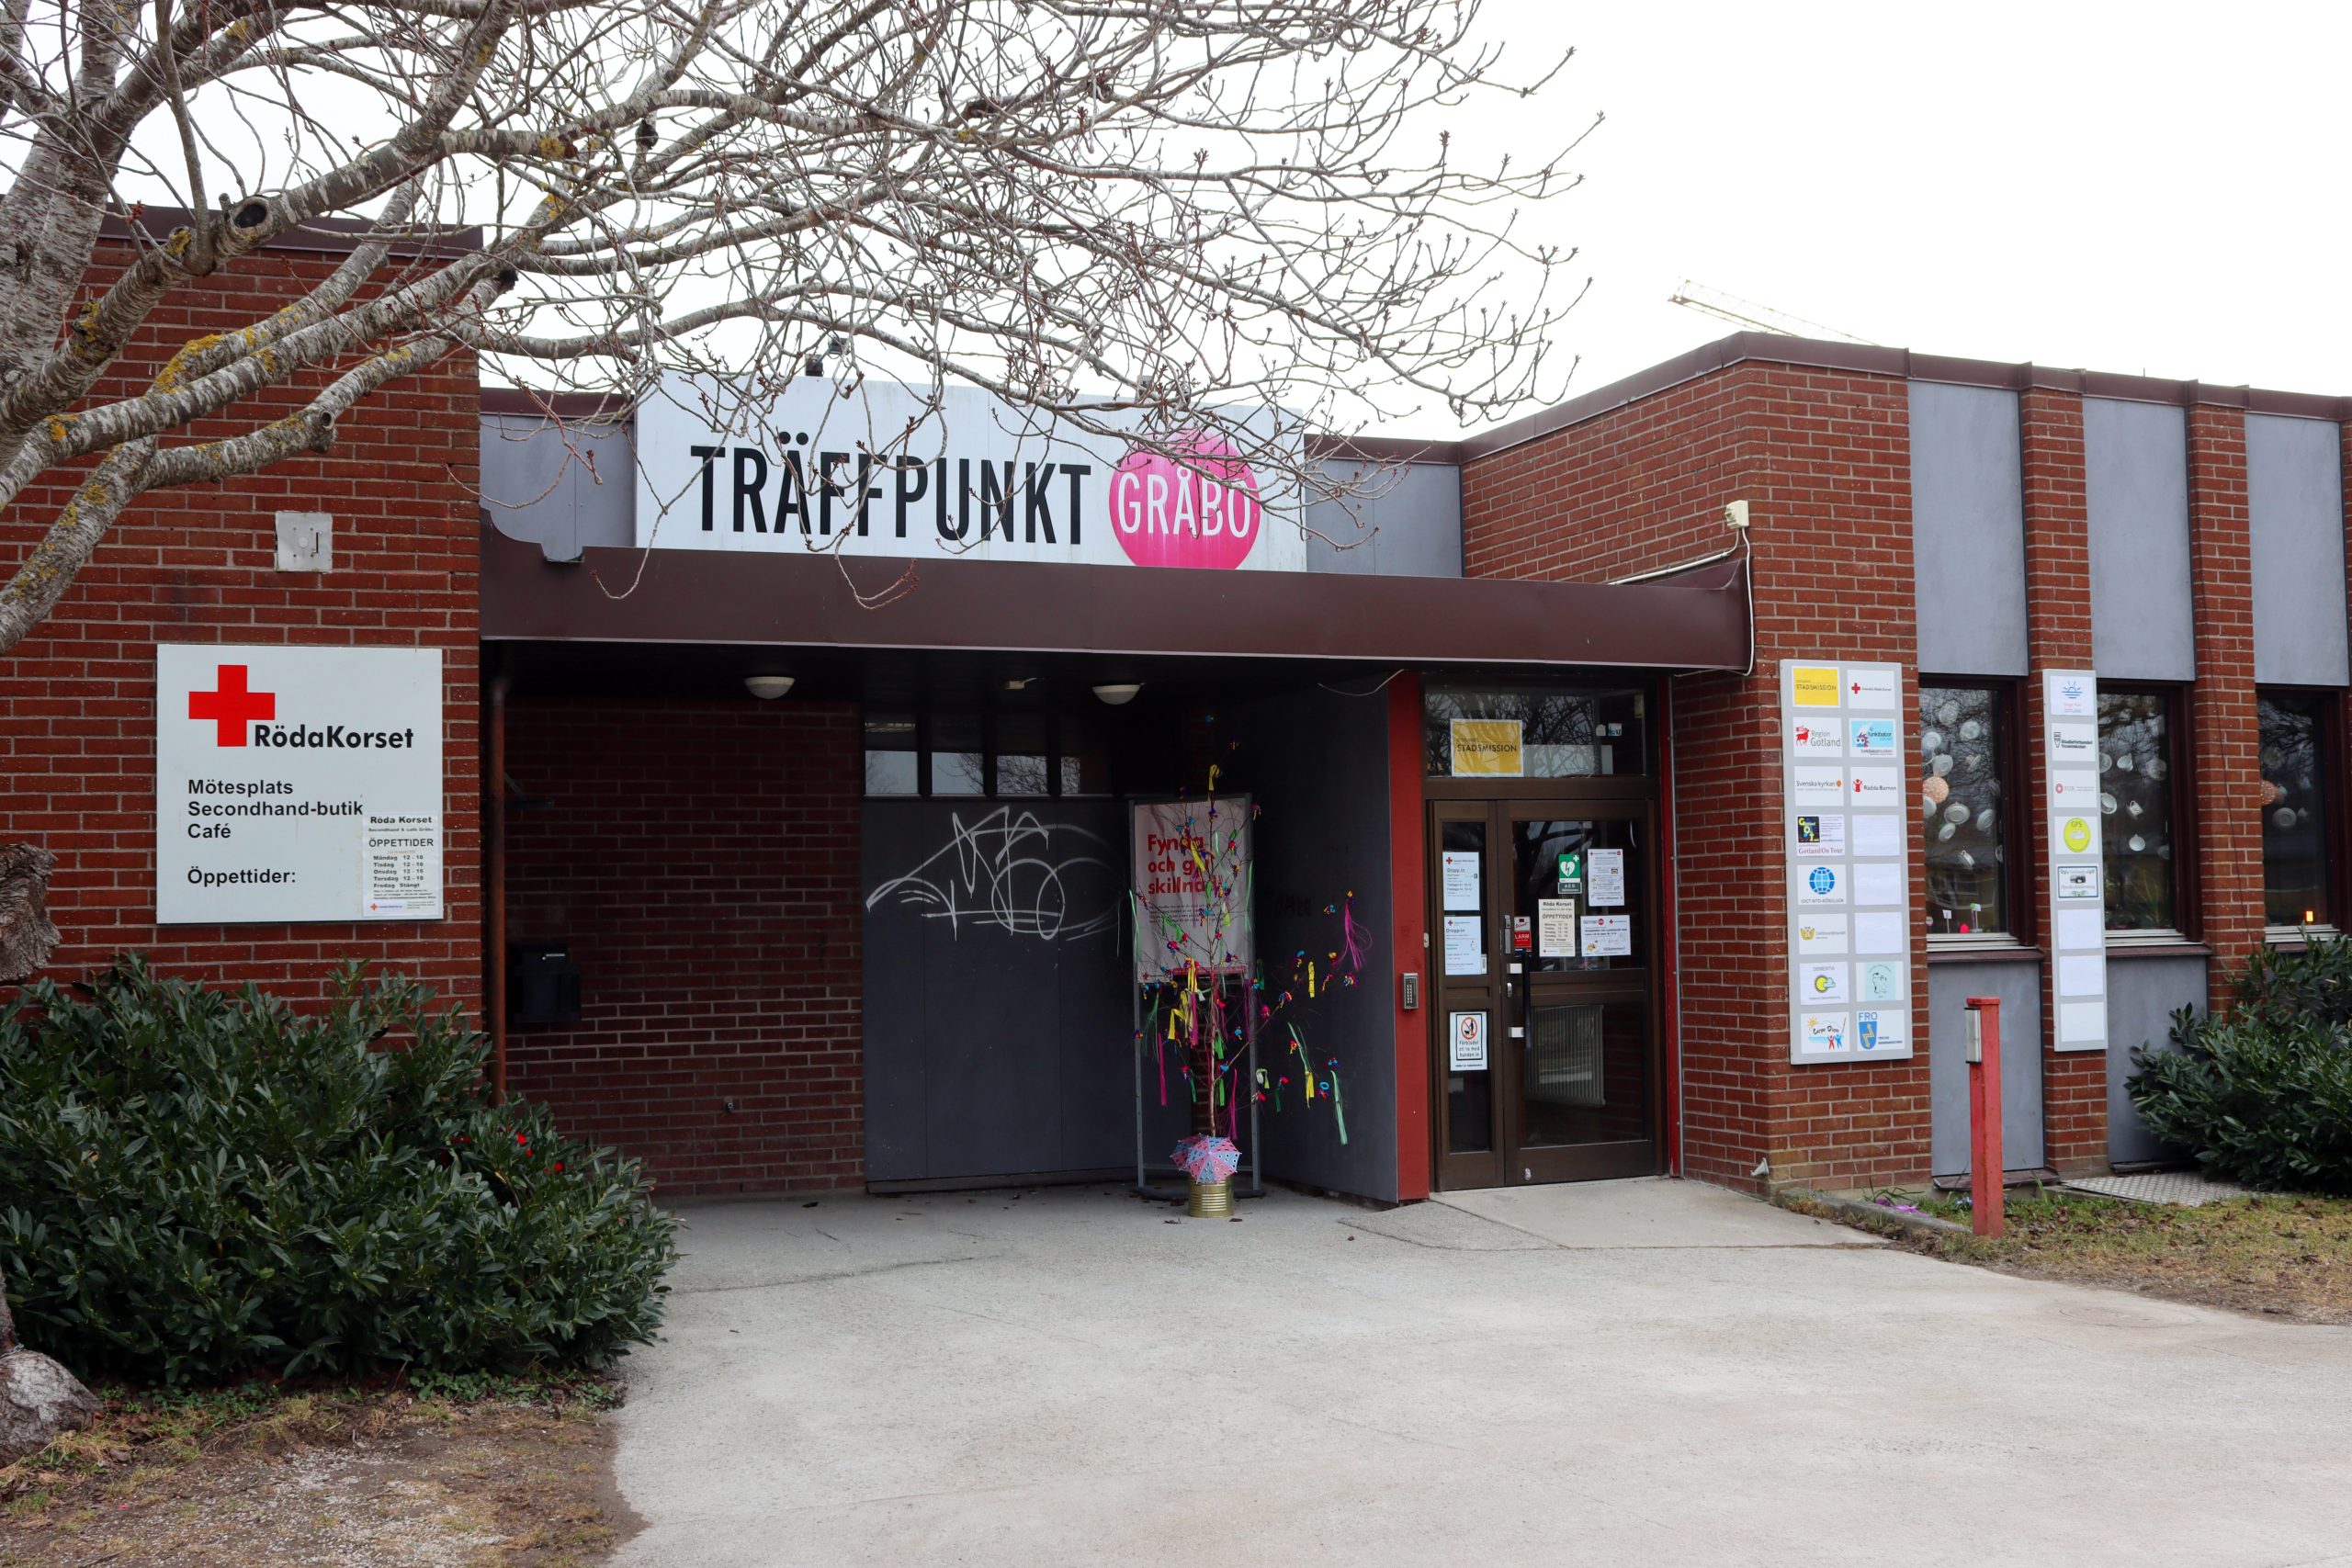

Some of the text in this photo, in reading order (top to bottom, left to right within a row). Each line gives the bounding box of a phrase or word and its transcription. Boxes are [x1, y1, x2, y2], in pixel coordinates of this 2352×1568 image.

[690, 431, 1251, 545] TRÄFFPUNKT GRÅBO
[254, 724, 413, 749] RödaKorset
[1810, 738, 1841, 747] Gotland
[1456, 744, 1517, 752] STADSMISSION
[187, 779, 294, 797] Mötesplats
[1817, 780, 1836, 788] kyrkan
[187, 801, 364, 817] Secondhand-butik
[370, 816, 432, 824] Röda Korset
[187, 822, 232, 839] Café
[368, 837, 435, 848] ÖPPETTIDER
[1148, 855, 1176, 873] och
[187, 866, 296, 887] Öppettider:
[1859, 1011, 1878, 1021] FRO
